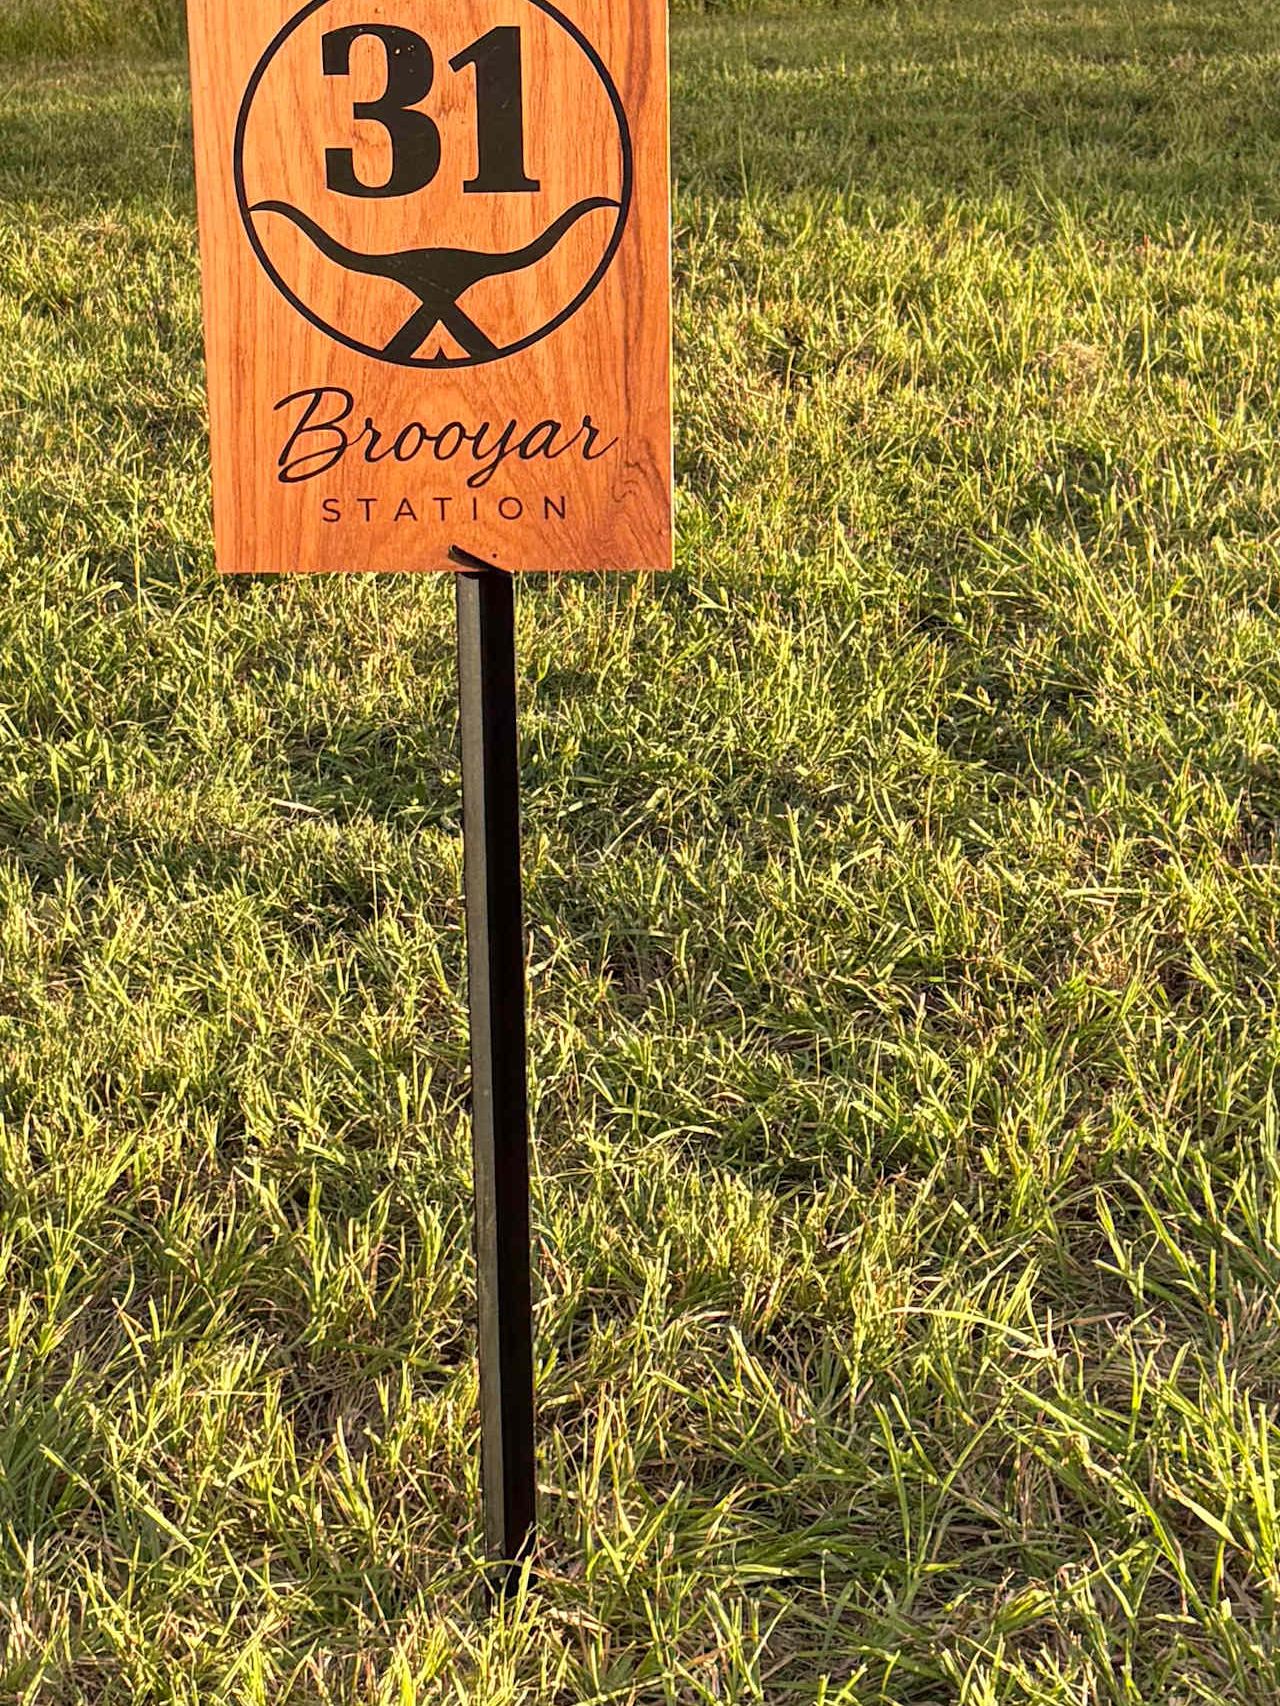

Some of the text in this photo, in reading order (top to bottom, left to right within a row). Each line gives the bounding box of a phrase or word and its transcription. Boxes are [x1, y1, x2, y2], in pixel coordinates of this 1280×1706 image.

[321, 23, 541, 198] 31
[273, 387, 619, 487] Brooyar
[321, 495, 566, 523] STATION
